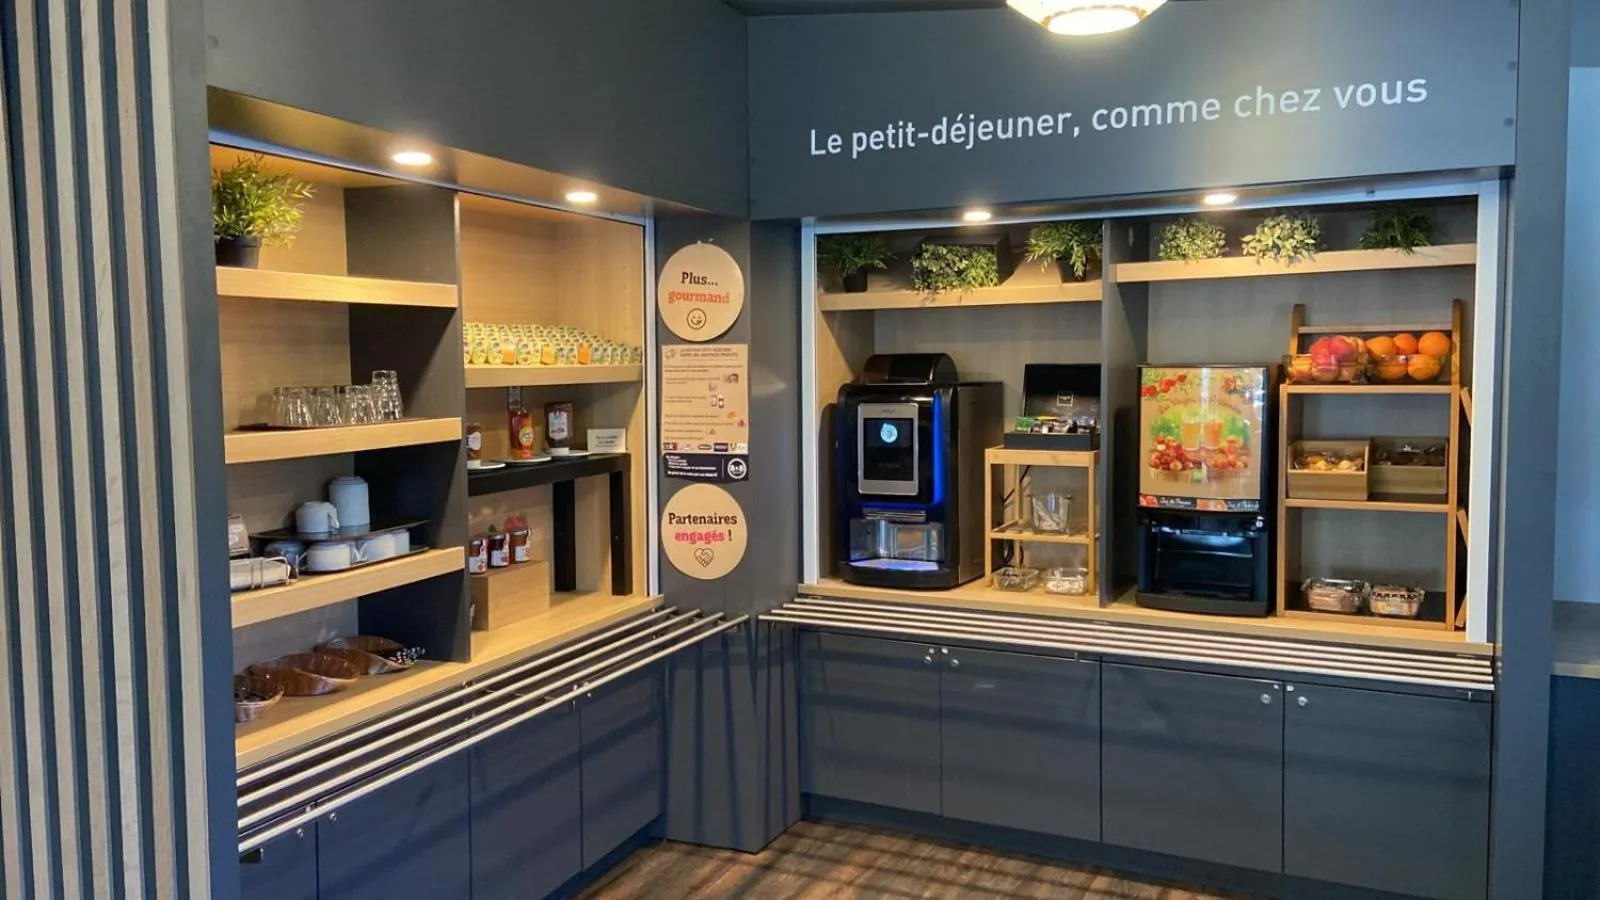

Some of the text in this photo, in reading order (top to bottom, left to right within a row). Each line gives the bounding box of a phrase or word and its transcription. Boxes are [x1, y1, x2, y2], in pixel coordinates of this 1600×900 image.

[810, 77, 1427, 160] Le petit-déjeuner, comme chez vous
[681, 271, 718, 286] Plus...
[669, 290, 730, 304] gourmand
[669, 513, 737, 525] Partenaires
[675, 529, 732, 545] engagés !
